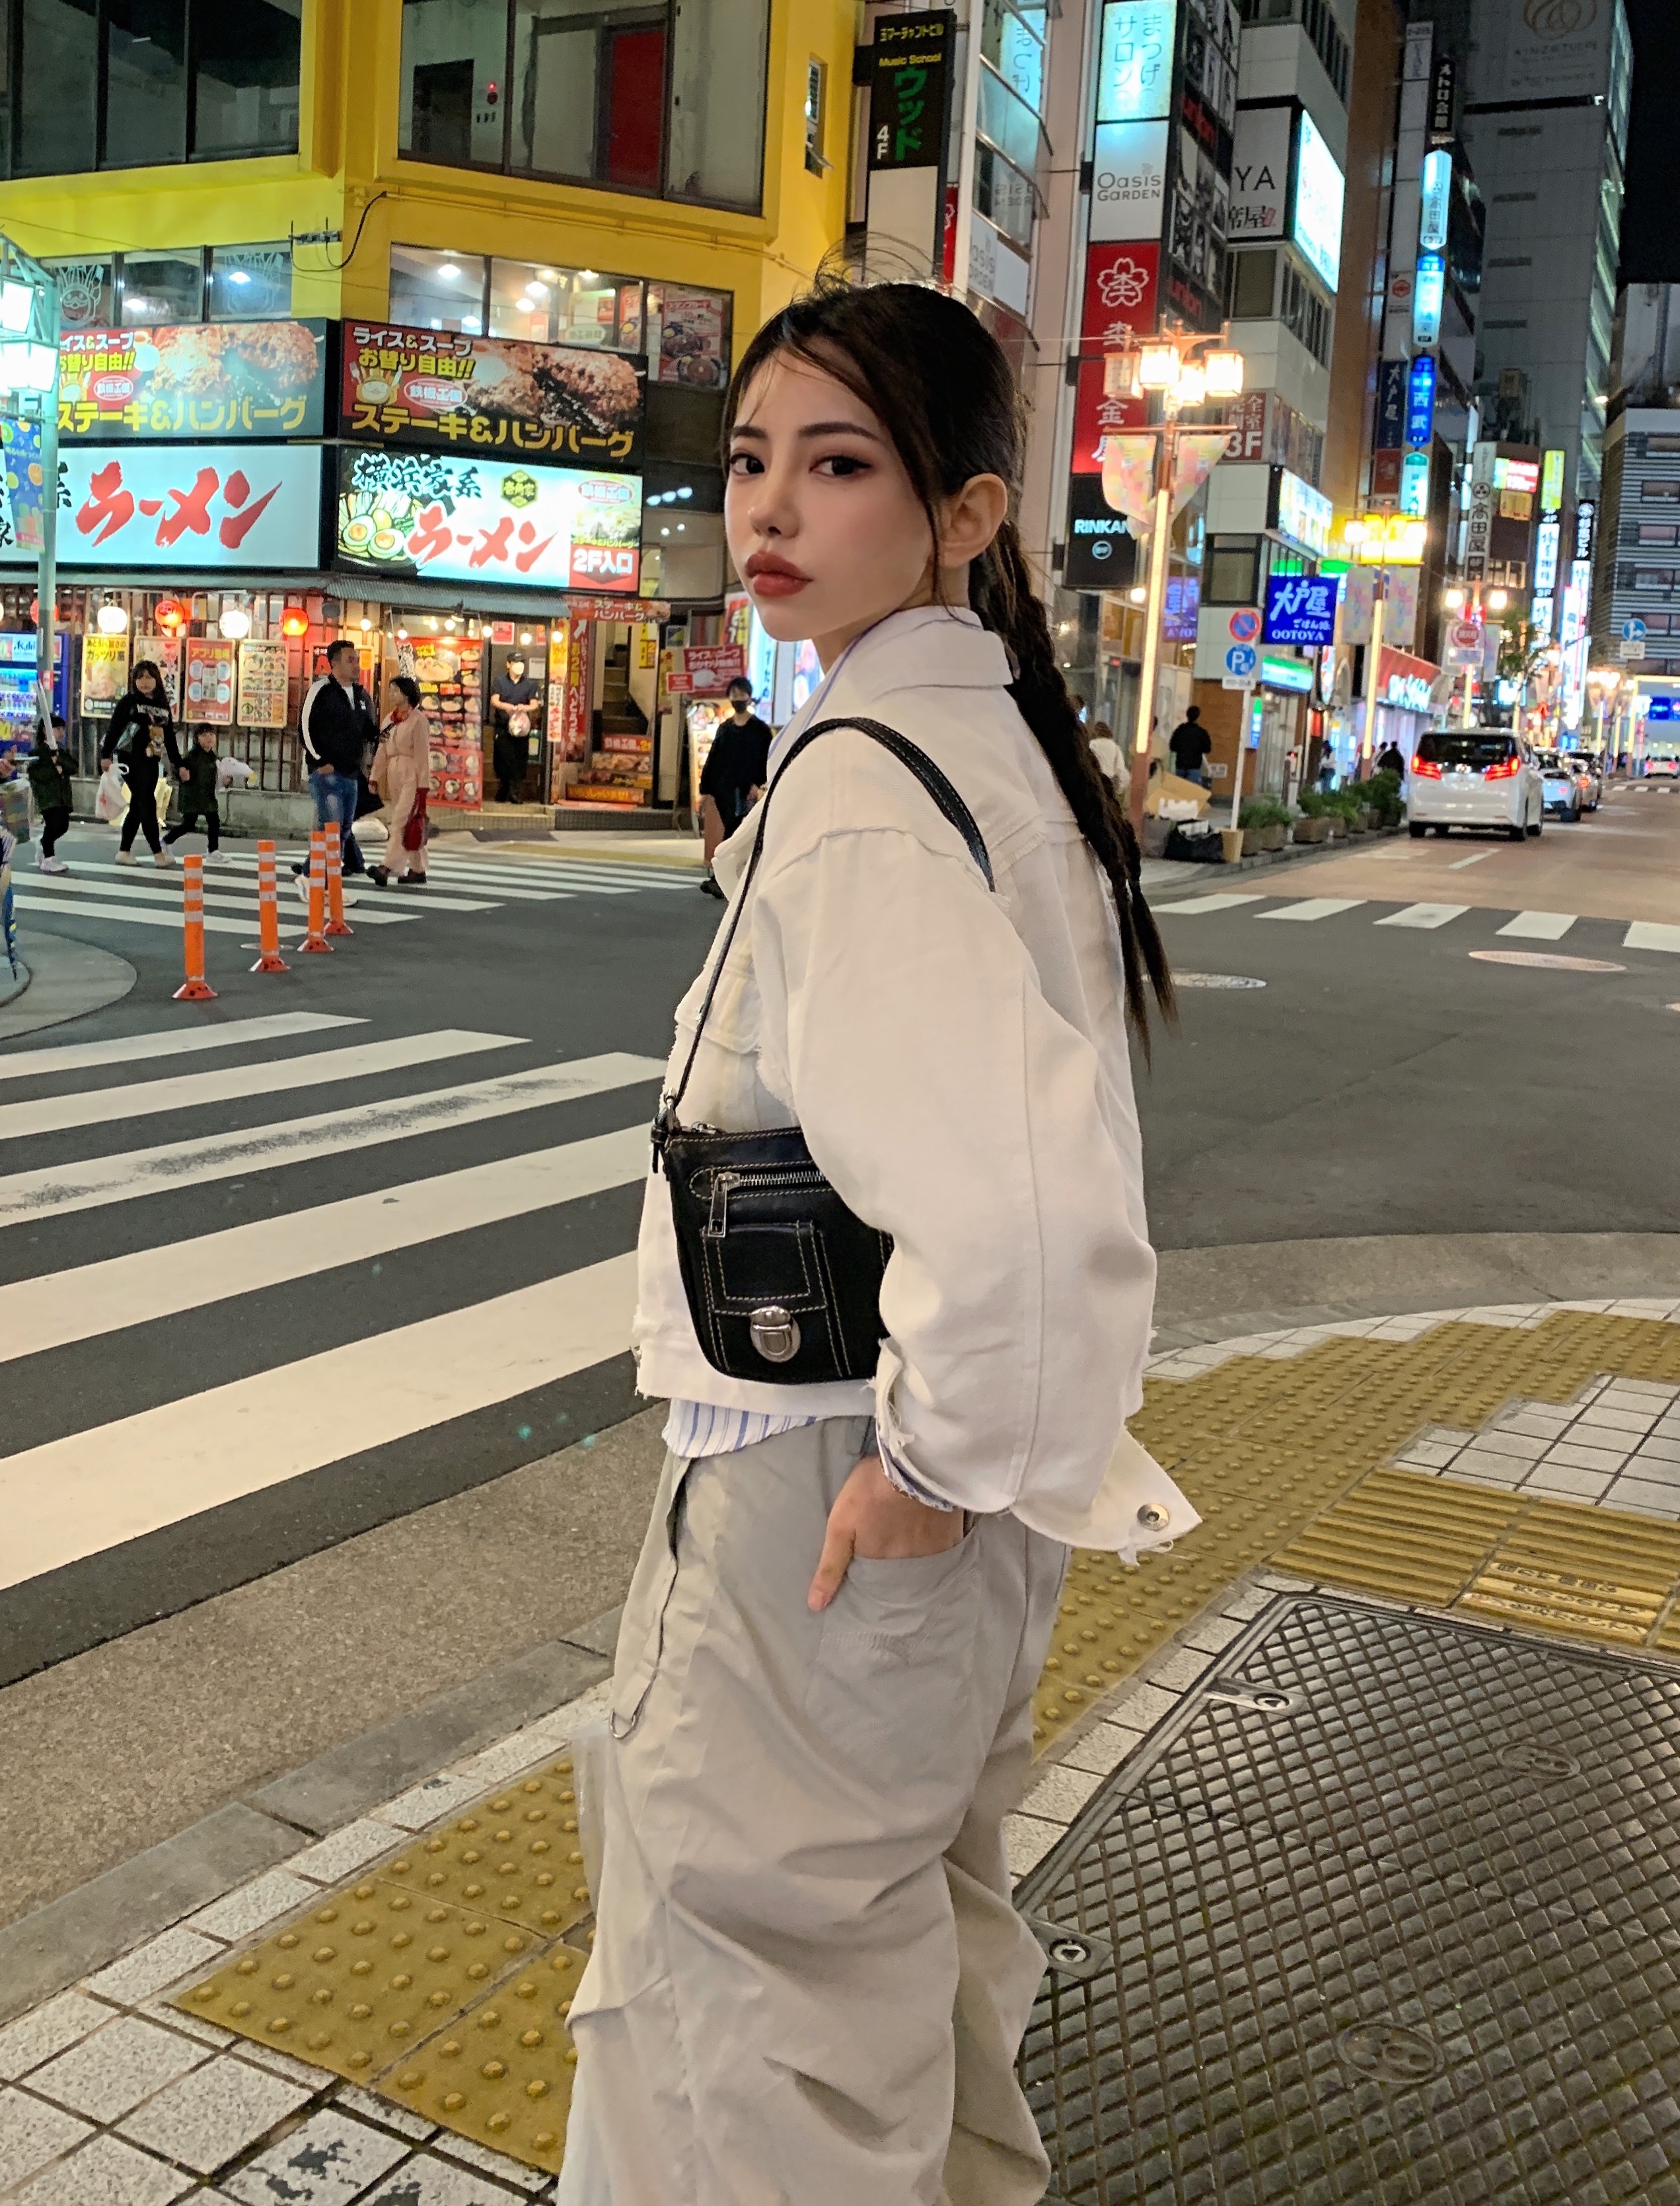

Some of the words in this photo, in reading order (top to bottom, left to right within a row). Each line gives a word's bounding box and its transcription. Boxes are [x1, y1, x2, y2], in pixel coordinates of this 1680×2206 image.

[879, 57, 908, 67] Music
[908, 54, 942, 65] School
[1113, 15, 1138, 87] サロン
[1140, 14, 1163, 86] まつげ
[894, 66, 929, 161] ウッド
[876, 124, 889, 160] 4F
[353, 326, 472, 357] ライス&スープ
[359, 348, 476, 379] お替り自由!!
[58, 394, 307, 433] ステーキ&ハンバーグ
[351, 403, 634, 457] ステーキ&ハンバーグ
[1224, 431, 1262, 457] 3F
[76, 460, 283, 550] ラーメン
[407, 505, 558, 573] ラーメン
[572, 548, 634, 575] 2F入口
[594, 610, 645, 622] ハンバーグ
[1270, 579, 1331, 622] 大戸屋
[1271, 628, 1325, 642] OOTOYA
[1231, 651, 1245, 673] P
